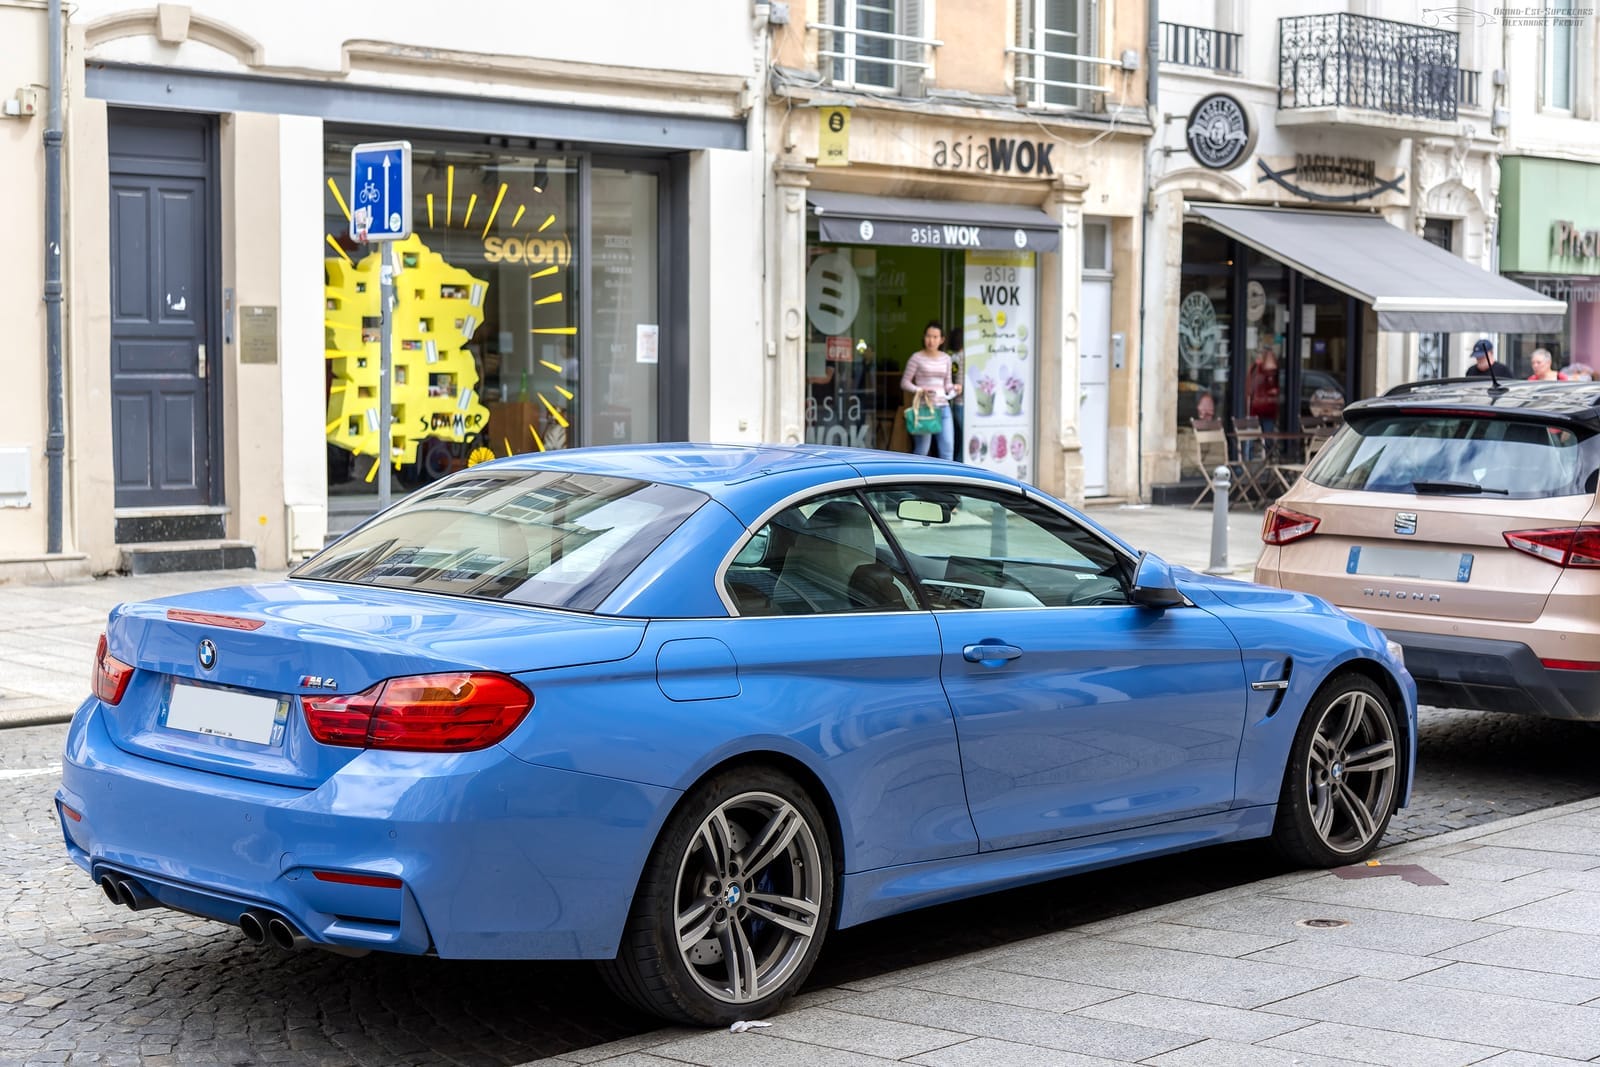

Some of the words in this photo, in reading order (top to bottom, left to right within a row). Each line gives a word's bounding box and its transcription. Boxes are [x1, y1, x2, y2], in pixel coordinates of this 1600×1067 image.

[911, 225, 941, 244] asia
[942, 225, 981, 247] WOK
[984, 265, 1016, 283] asia
[980, 285, 1020, 306] WOK
[806, 388, 861, 422] asia
[306, 675, 338, 690] M4
